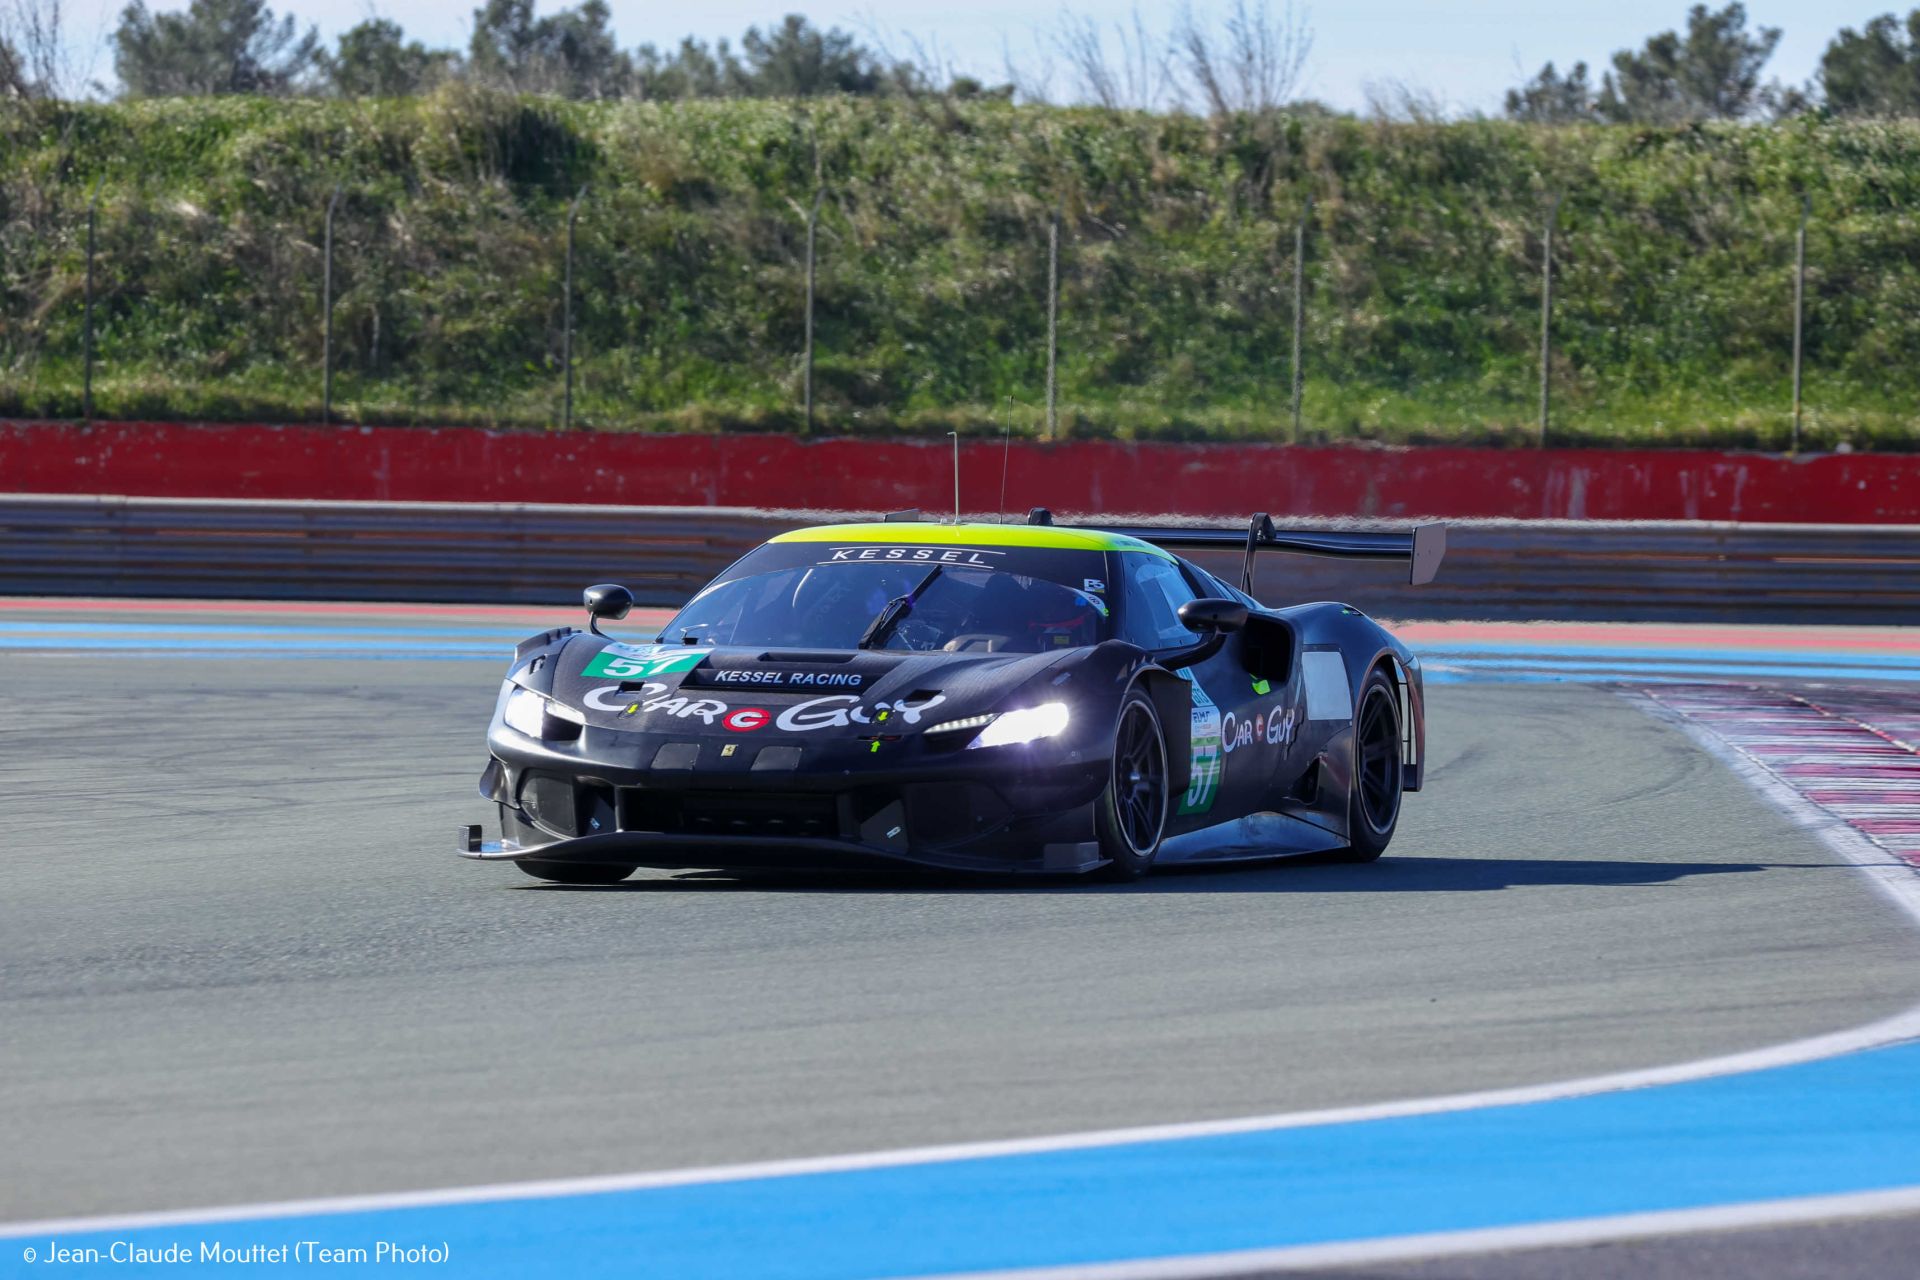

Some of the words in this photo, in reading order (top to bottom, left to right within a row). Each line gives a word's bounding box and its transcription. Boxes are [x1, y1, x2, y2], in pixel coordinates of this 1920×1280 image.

[832, 549, 985, 565] KESSEL
[603, 655, 691, 677] 57
[715, 670, 784, 684] KESSEL
[788, 672, 862, 686] RACING
[1187, 745, 1217, 807] 57
